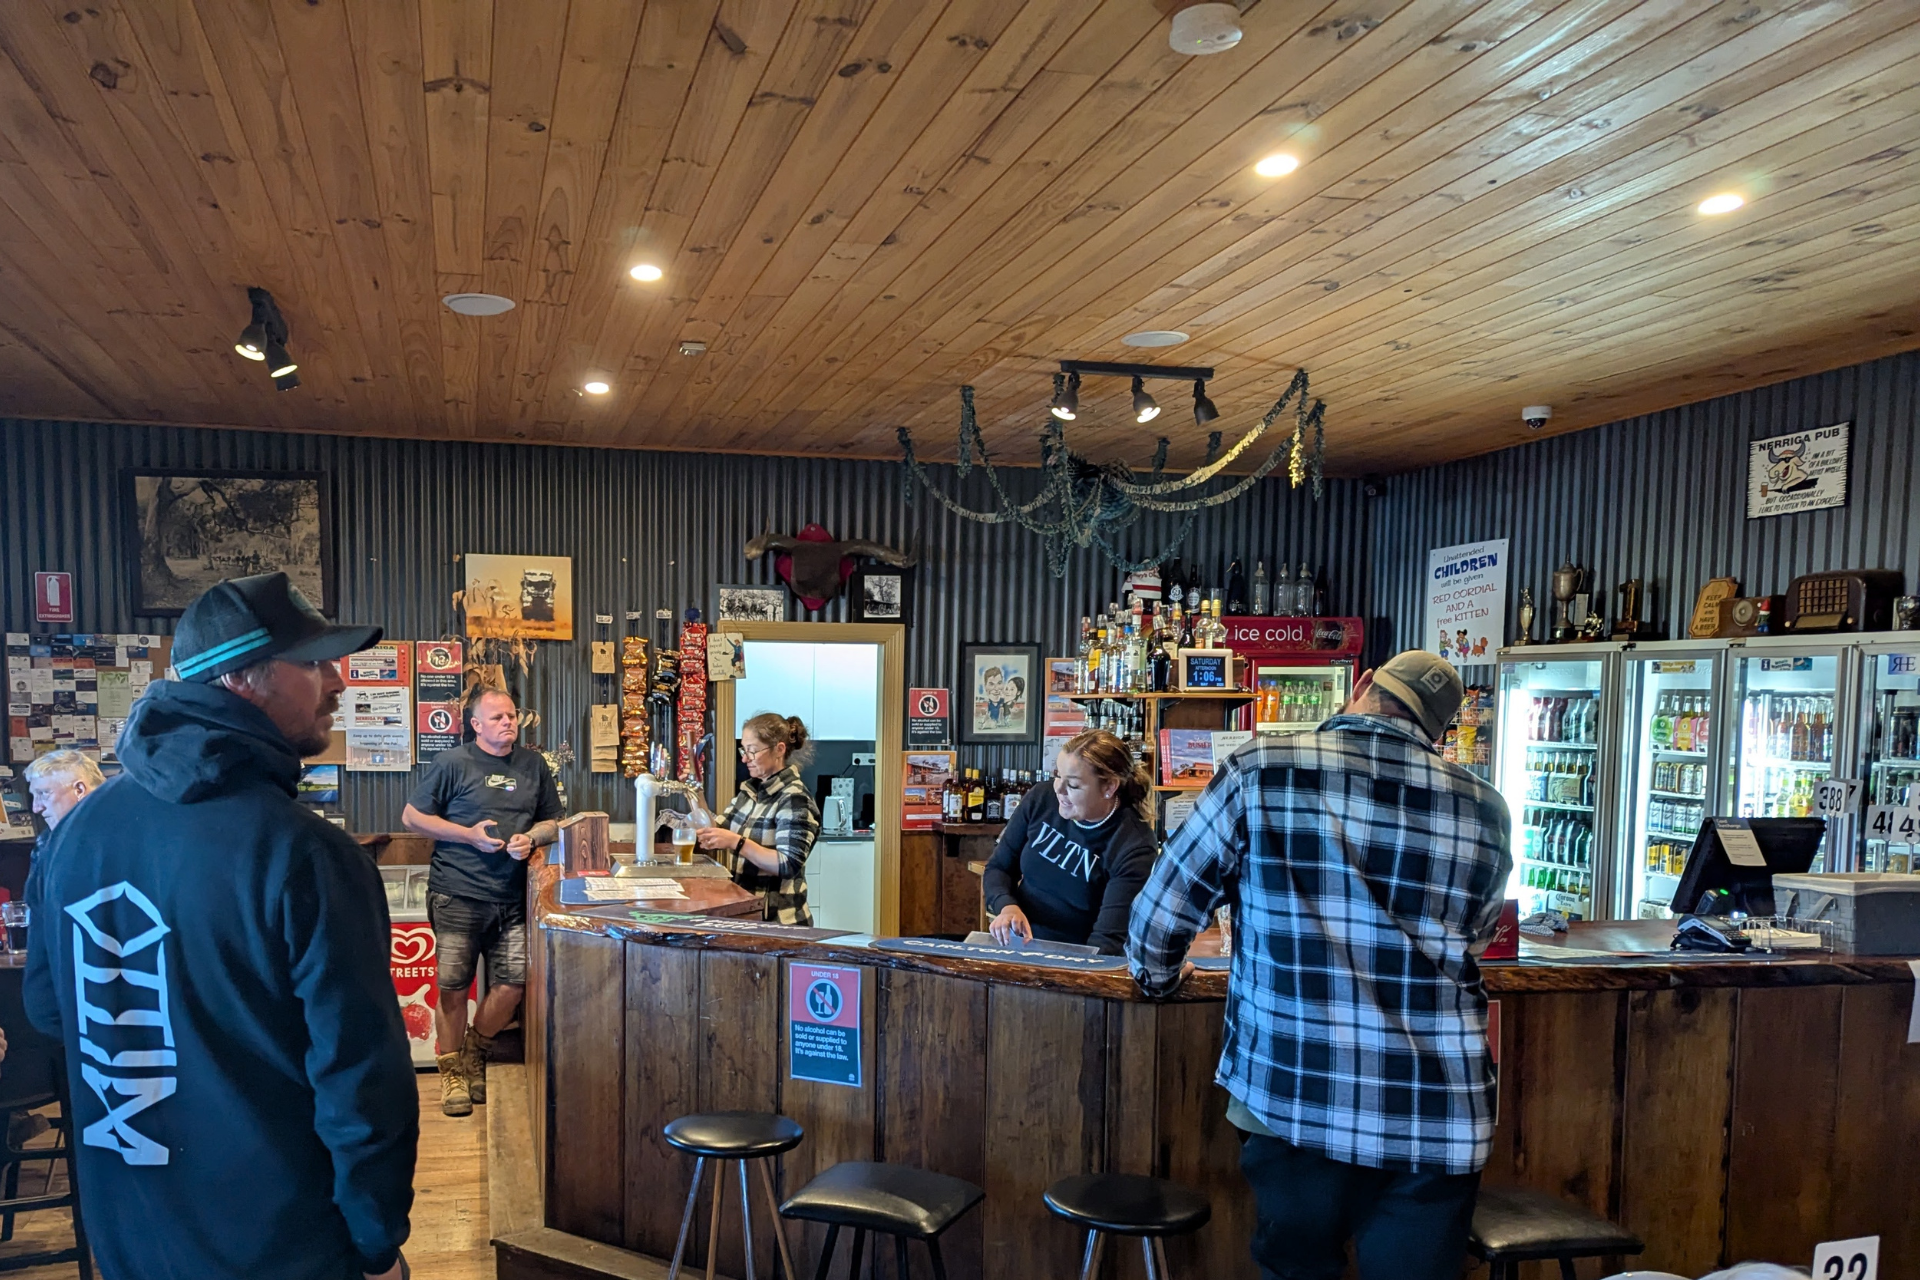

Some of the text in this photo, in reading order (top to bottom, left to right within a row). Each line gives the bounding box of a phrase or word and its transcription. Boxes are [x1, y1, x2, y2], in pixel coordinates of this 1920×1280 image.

[1759, 428, 1840, 452] NERRIGA PUB
[1444, 546, 1485, 562] Unattended
[1434, 553, 1498, 579] CHILDREN
[1441, 579, 1451, 588] will
[1464, 573, 1484, 585] given
[1433, 583, 1497, 604] RED CORDIAL
[1446, 600, 1474, 613] AND A
[1437, 608, 1489, 628] free KITTEN
[1234, 625, 1260, 641] ice
[1265, 625, 1303, 641] cold
[1193, 671, 1214, 681] 1:06
[1031, 822, 1100, 882] VLTN
[1555, 894, 1576, 903] Corona
[903, 940, 1106, 964] CARLTON DRY
[804, 1026, 825, 1035] alcohol
[838, 1029, 845, 1037] be
[795, 1041, 816, 1049] anyone
[815, 1035, 840, 1045] supplied
[804, 1049, 826, 1058] against
[837, 1053, 849, 1061] law.
